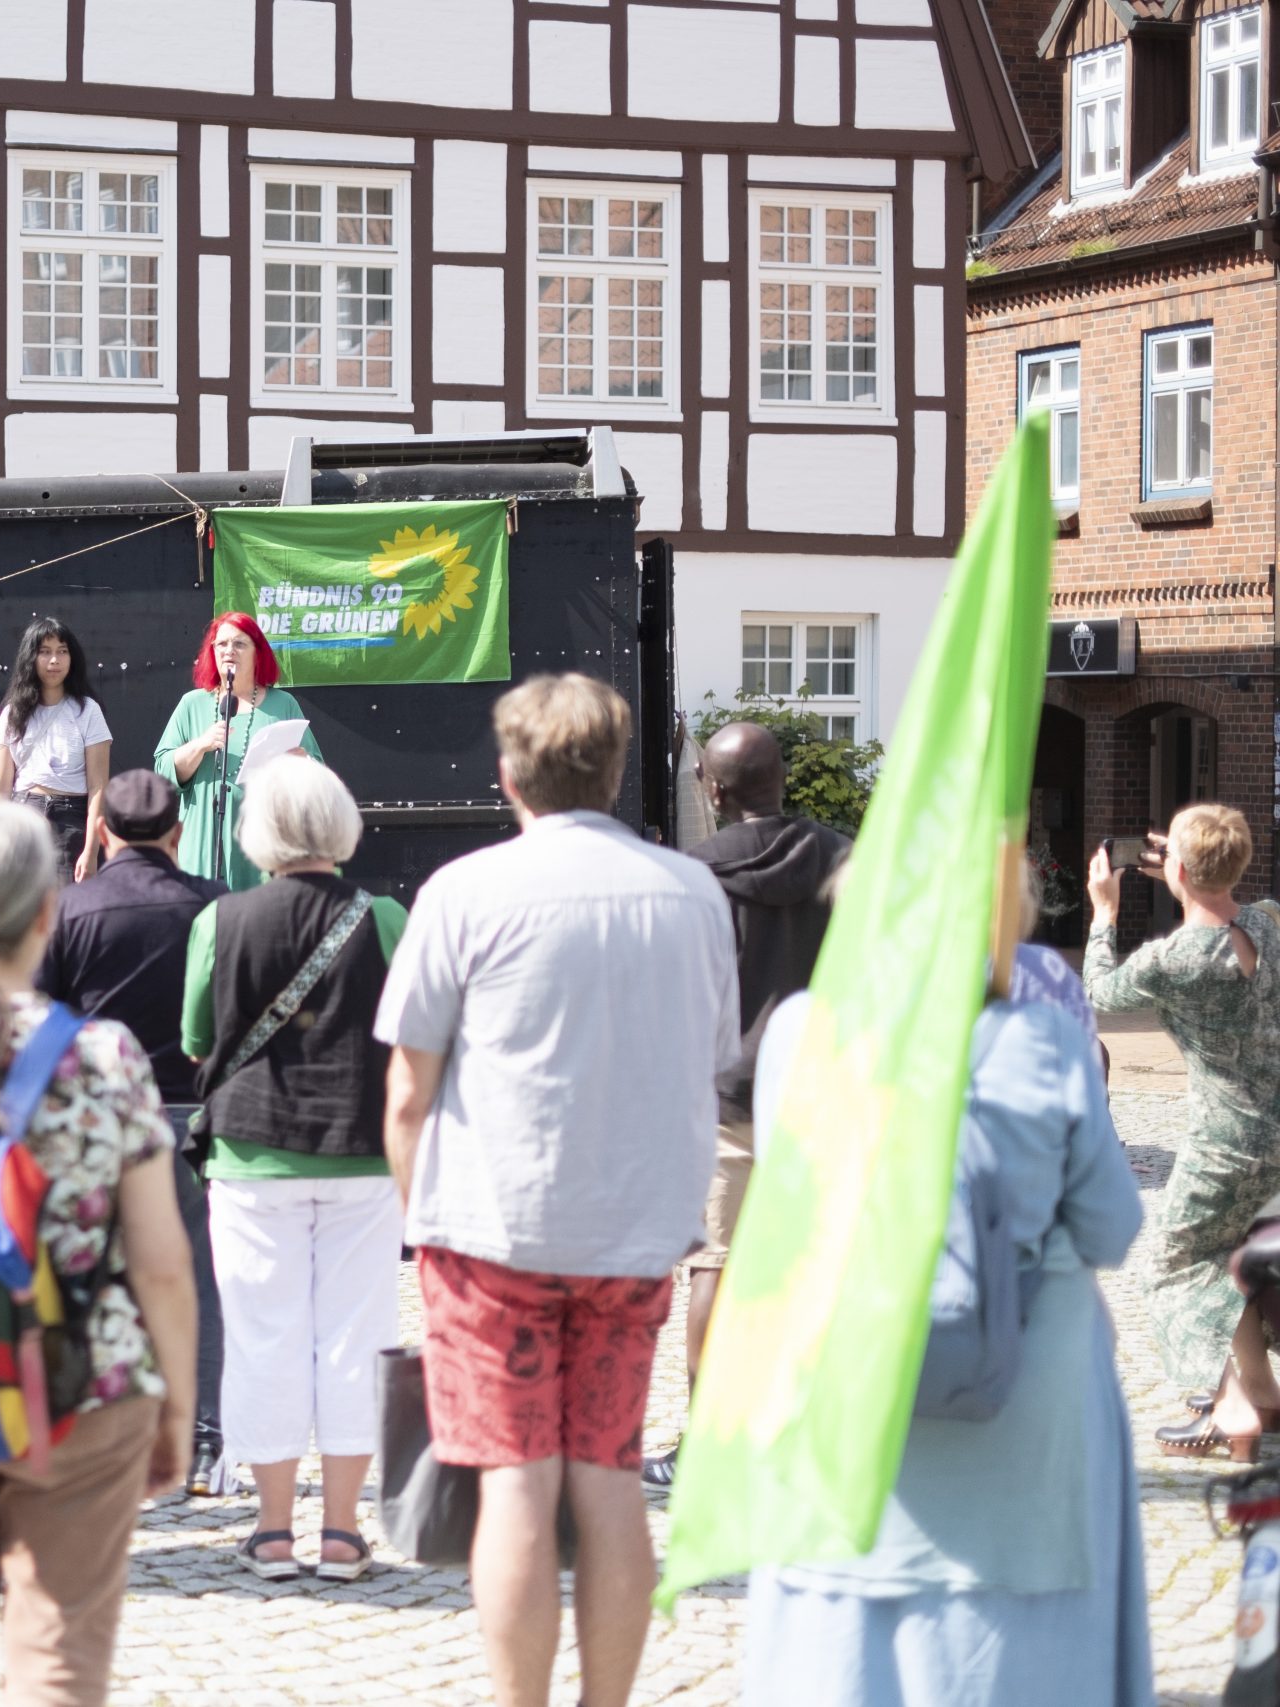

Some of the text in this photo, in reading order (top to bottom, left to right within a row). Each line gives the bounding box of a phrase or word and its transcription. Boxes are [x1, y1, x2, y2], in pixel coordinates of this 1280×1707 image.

[258, 581, 403, 608] BÜNDNIS 90
[256, 606, 400, 635] DIE GRÜNEN
